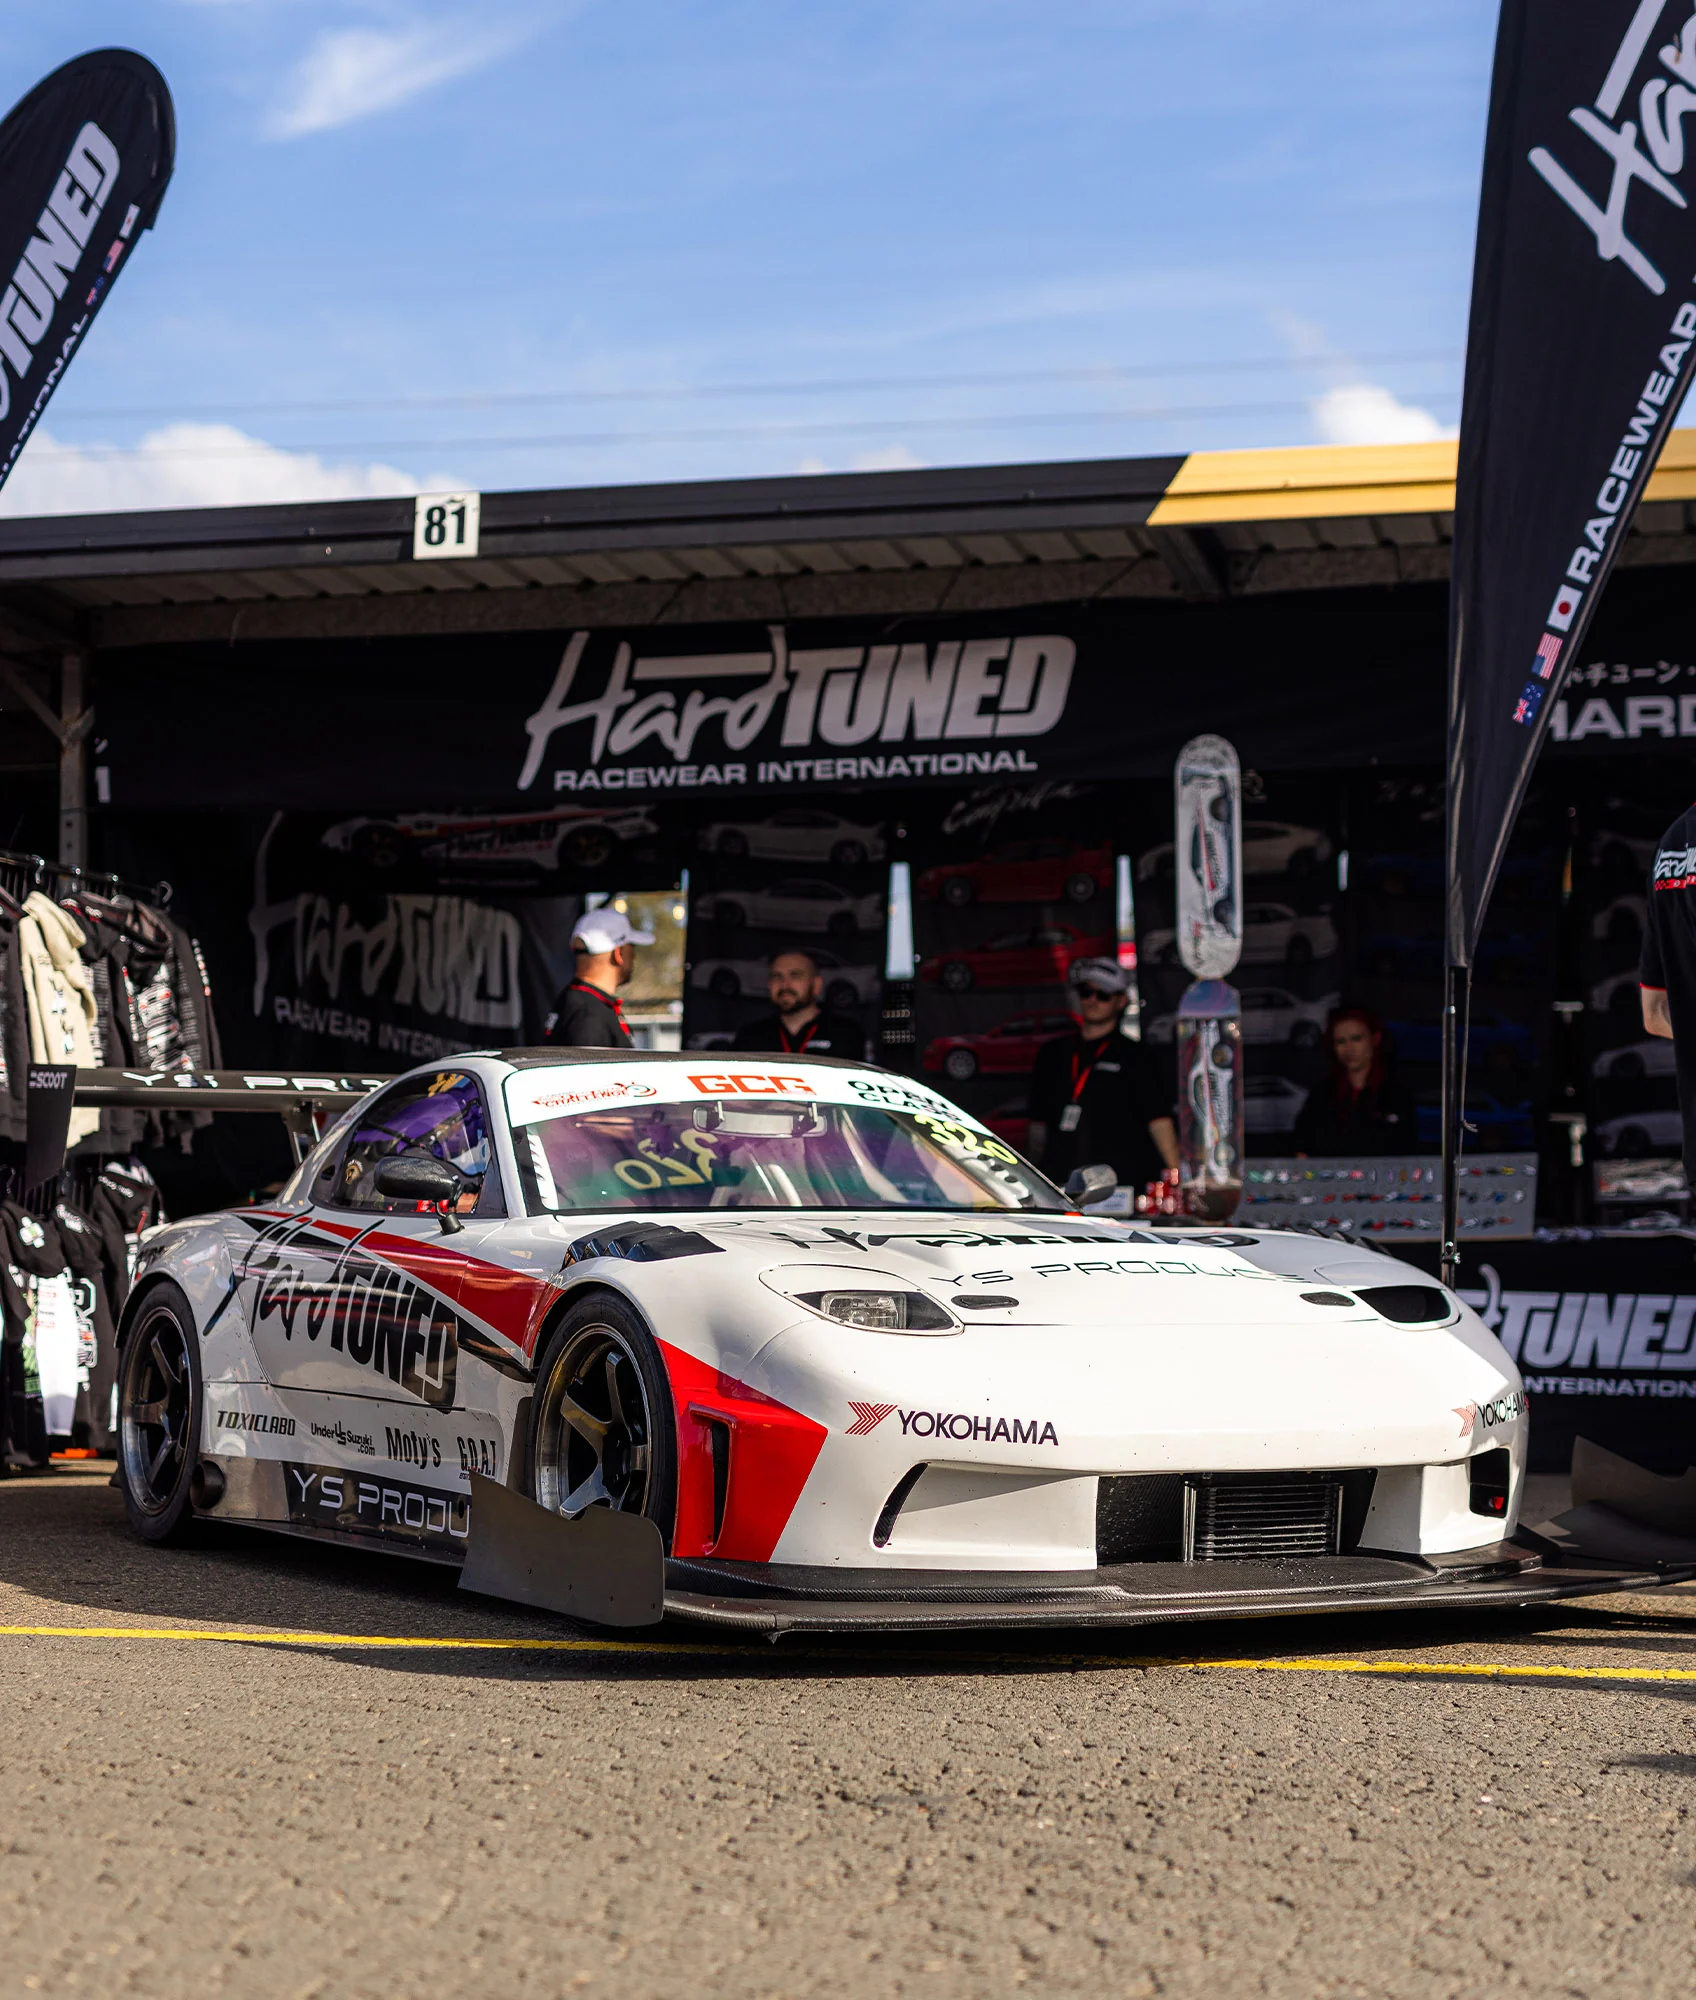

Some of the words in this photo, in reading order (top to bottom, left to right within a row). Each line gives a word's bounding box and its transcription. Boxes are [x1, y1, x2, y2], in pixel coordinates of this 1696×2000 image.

[1567, 302, 1696, 584] RACEWEAR
[423, 505, 467, 545] 81
[554, 762, 746, 791] RACEWEAR
[758, 750, 1038, 783] INTERNATIONAL
[687, 1075, 817, 1096] GCG
[848, 1080, 949, 1110] OPEN
[914, 1113, 1018, 1165] 320
[928, 1270, 1014, 1286] YS
[1030, 1260, 1312, 1283] PRODUCE
[1523, 1376, 1696, 1398] NTERNATION
[217, 1410, 295, 1436] TOXICLABO
[898, 1409, 1059, 1446] YOKOHAMA
[387, 1427, 442, 1470] Moty's
[292, 1469, 344, 1510] YS
[358, 1482, 471, 1537] PRODU
